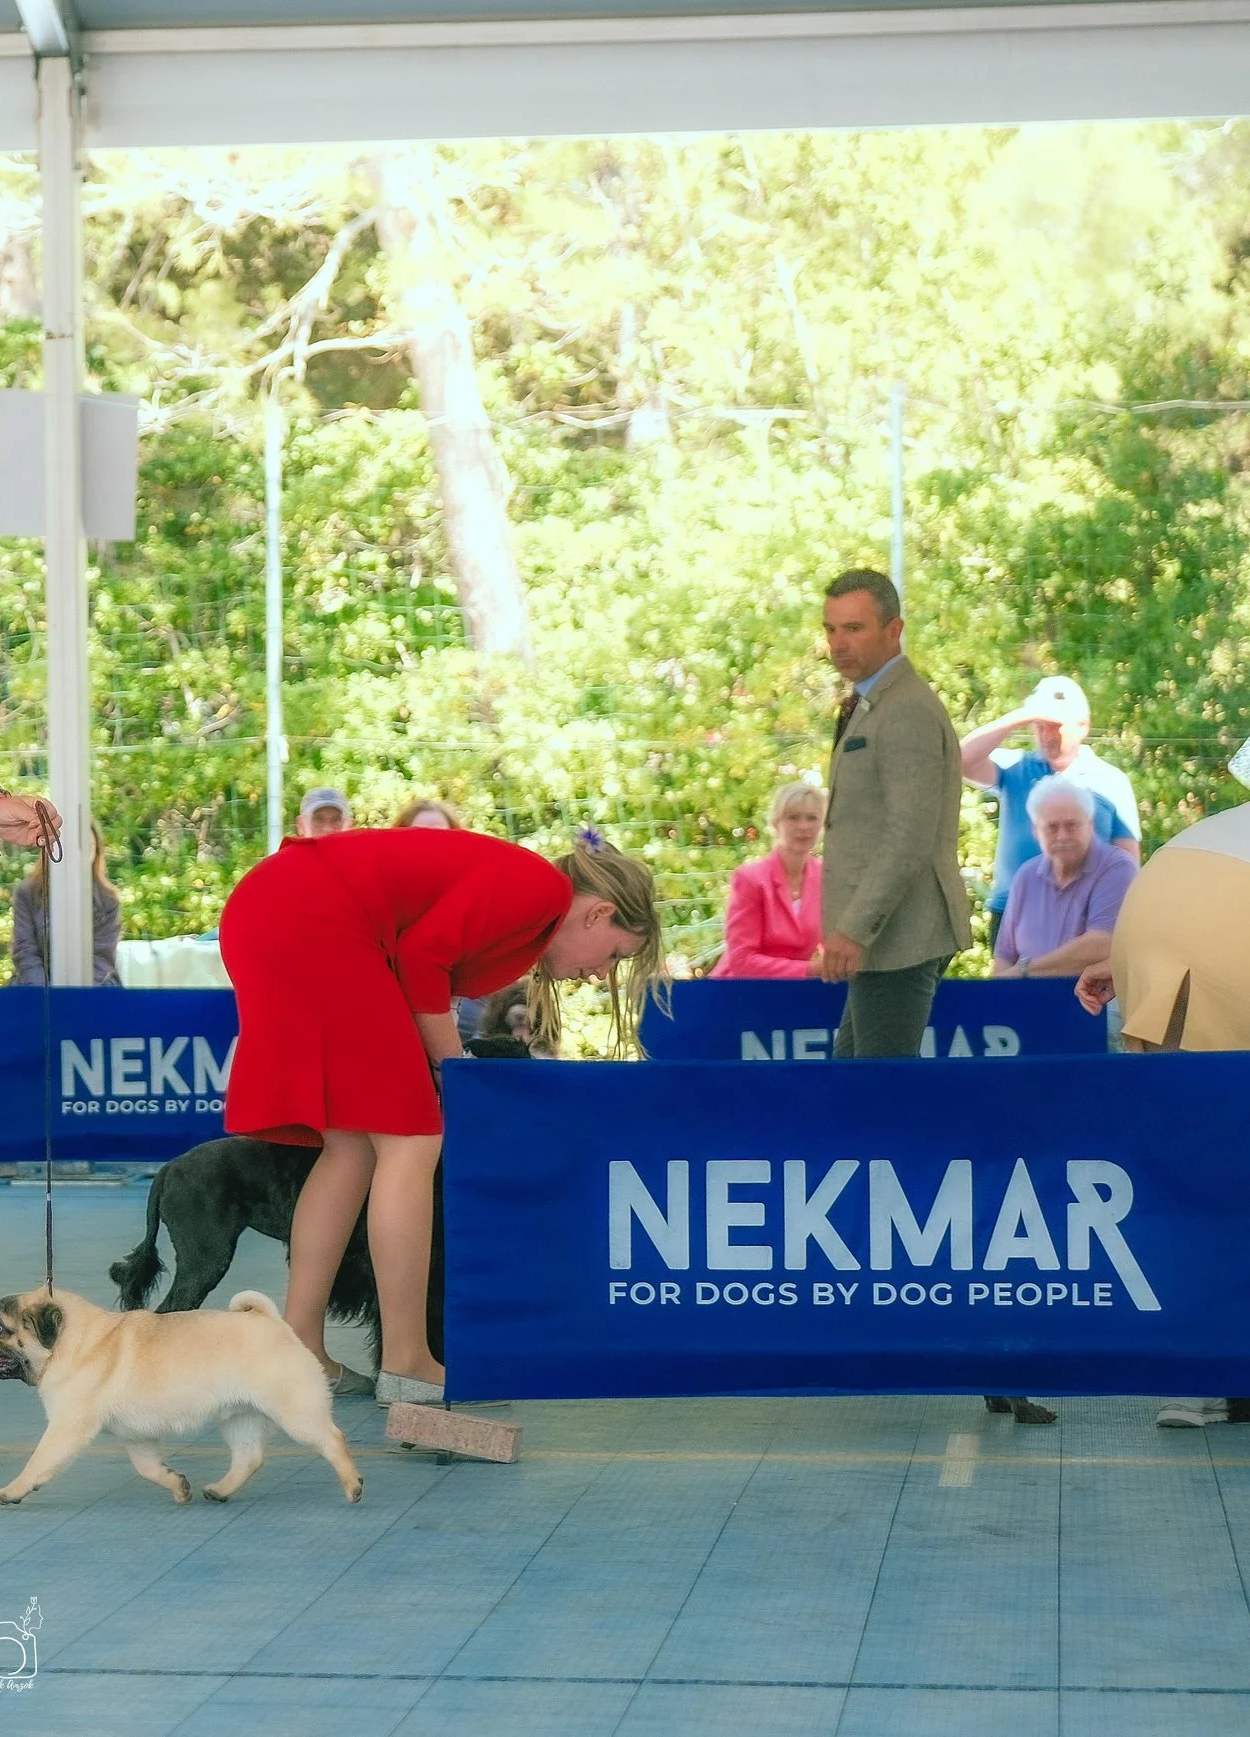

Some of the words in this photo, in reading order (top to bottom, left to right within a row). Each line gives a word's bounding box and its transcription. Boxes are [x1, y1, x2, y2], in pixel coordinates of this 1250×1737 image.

[60, 1036, 239, 1097] NEKM
[61, 1100, 100, 1113] FOR
[105, 1099, 159, 1113] DOGS
[165, 1099, 190, 1112] BY
[609, 1157, 1162, 1311] NEKMAR
[609, 1281, 681, 1305] FOR
[696, 1282, 798, 1306] DOGS
[813, 1282, 859, 1305] BY
[873, 1282, 953, 1306] DOG
[968, 1282, 1113, 1306] PEOPLE
